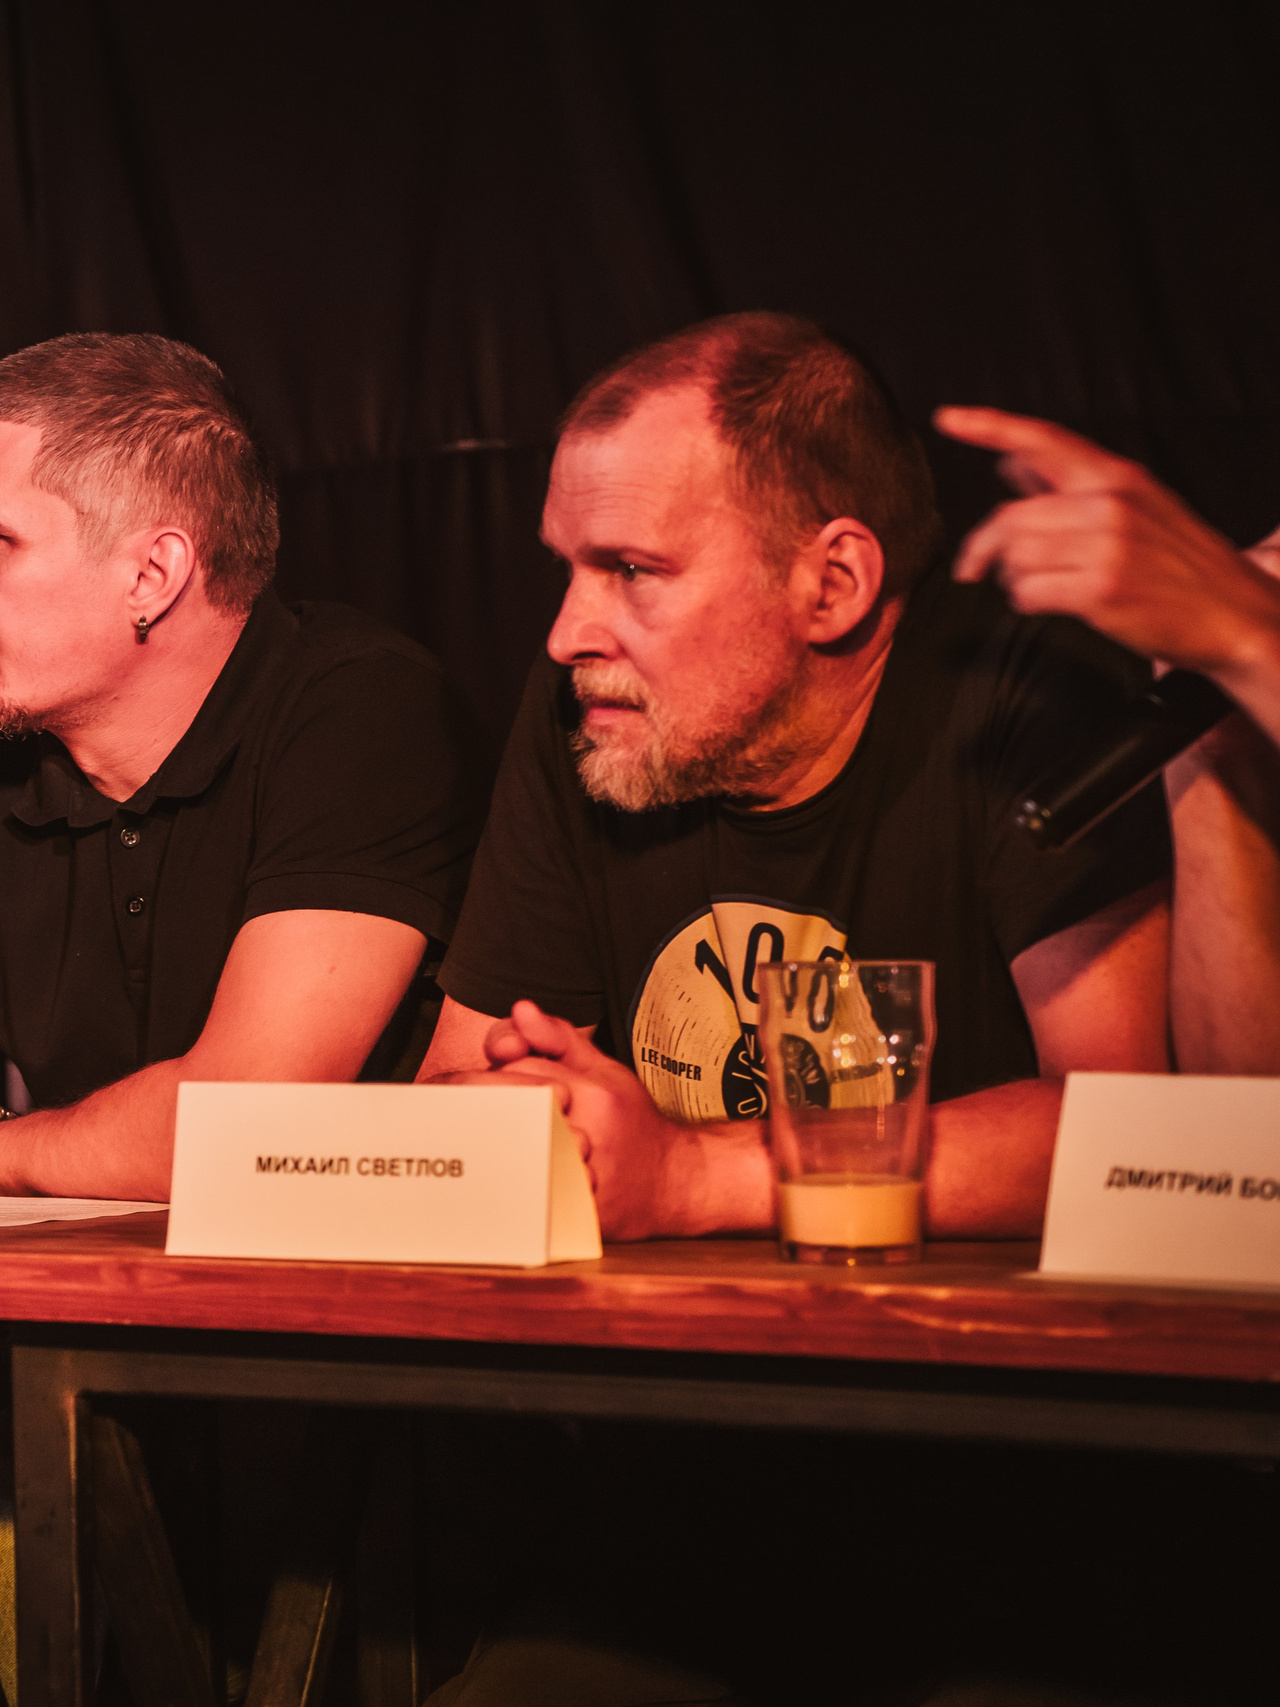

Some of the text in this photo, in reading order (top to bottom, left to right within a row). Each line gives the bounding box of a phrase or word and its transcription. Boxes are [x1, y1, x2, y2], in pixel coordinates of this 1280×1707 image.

[640, 1046, 702, 1082] LEE COOPER
[255, 1156, 465, 1178] МИХАИЛ СВЕТЛОВ
[1104, 1165, 1280, 1202] ДМИТРИЙ БО
